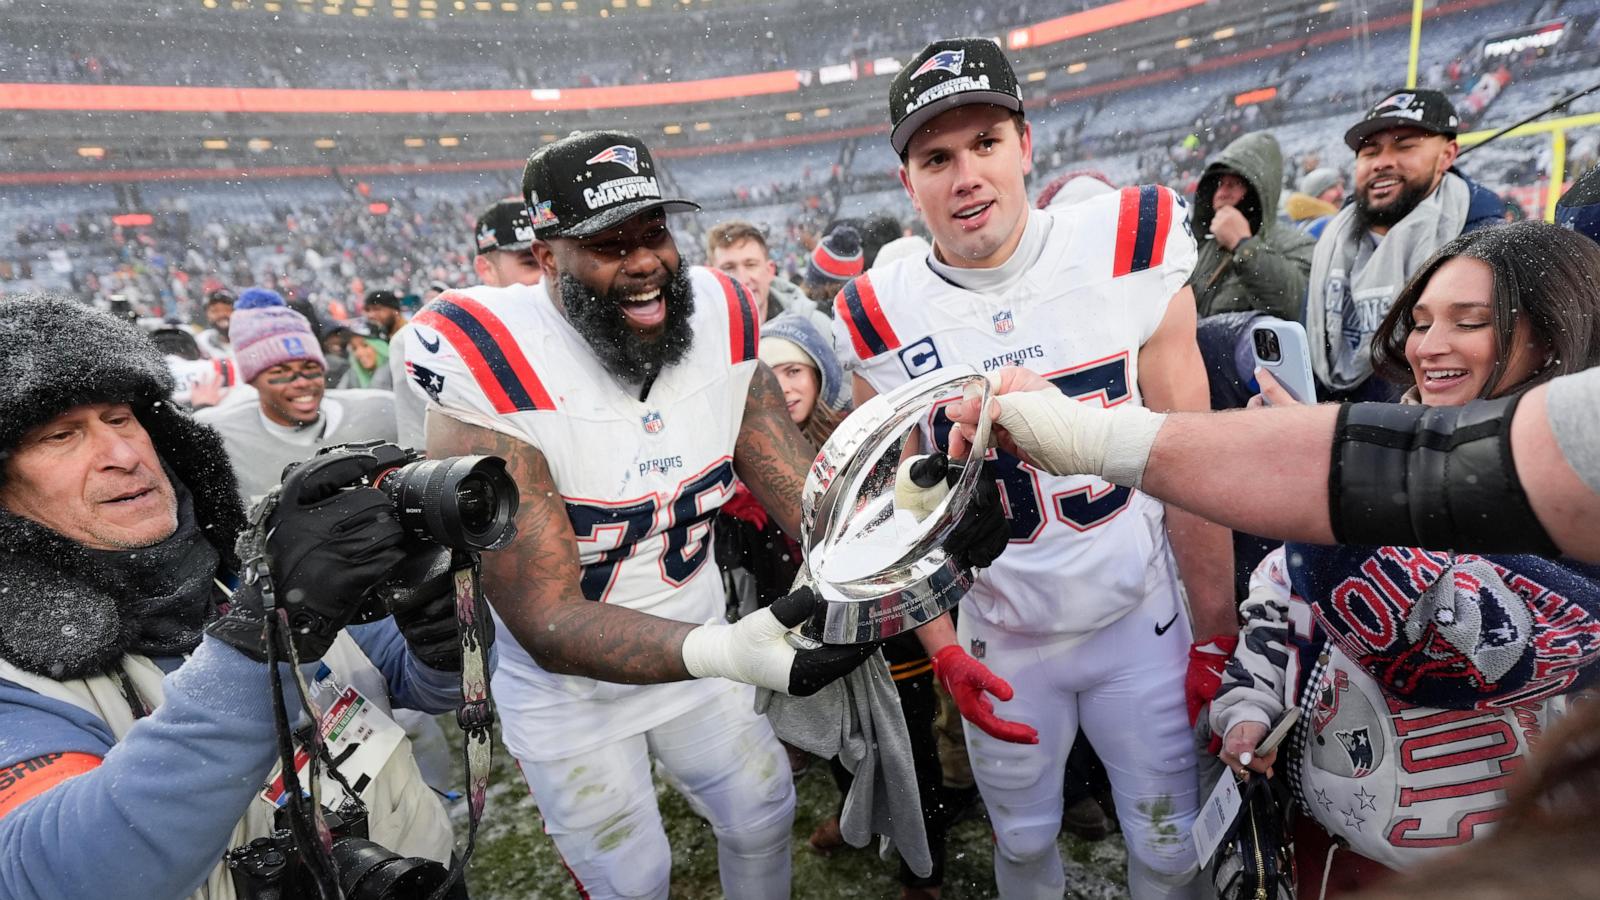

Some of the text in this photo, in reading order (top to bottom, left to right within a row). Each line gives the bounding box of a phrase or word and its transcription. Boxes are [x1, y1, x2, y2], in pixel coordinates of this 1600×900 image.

[995, 320, 1014, 333] NFL
[901, 341, 940, 376] C
[983, 345, 1044, 371] PATRIOTS
[640, 456, 682, 477] PTRIOTS
[560, 456, 736, 602] 76
[874, 611, 905, 623] FOOTBALL
